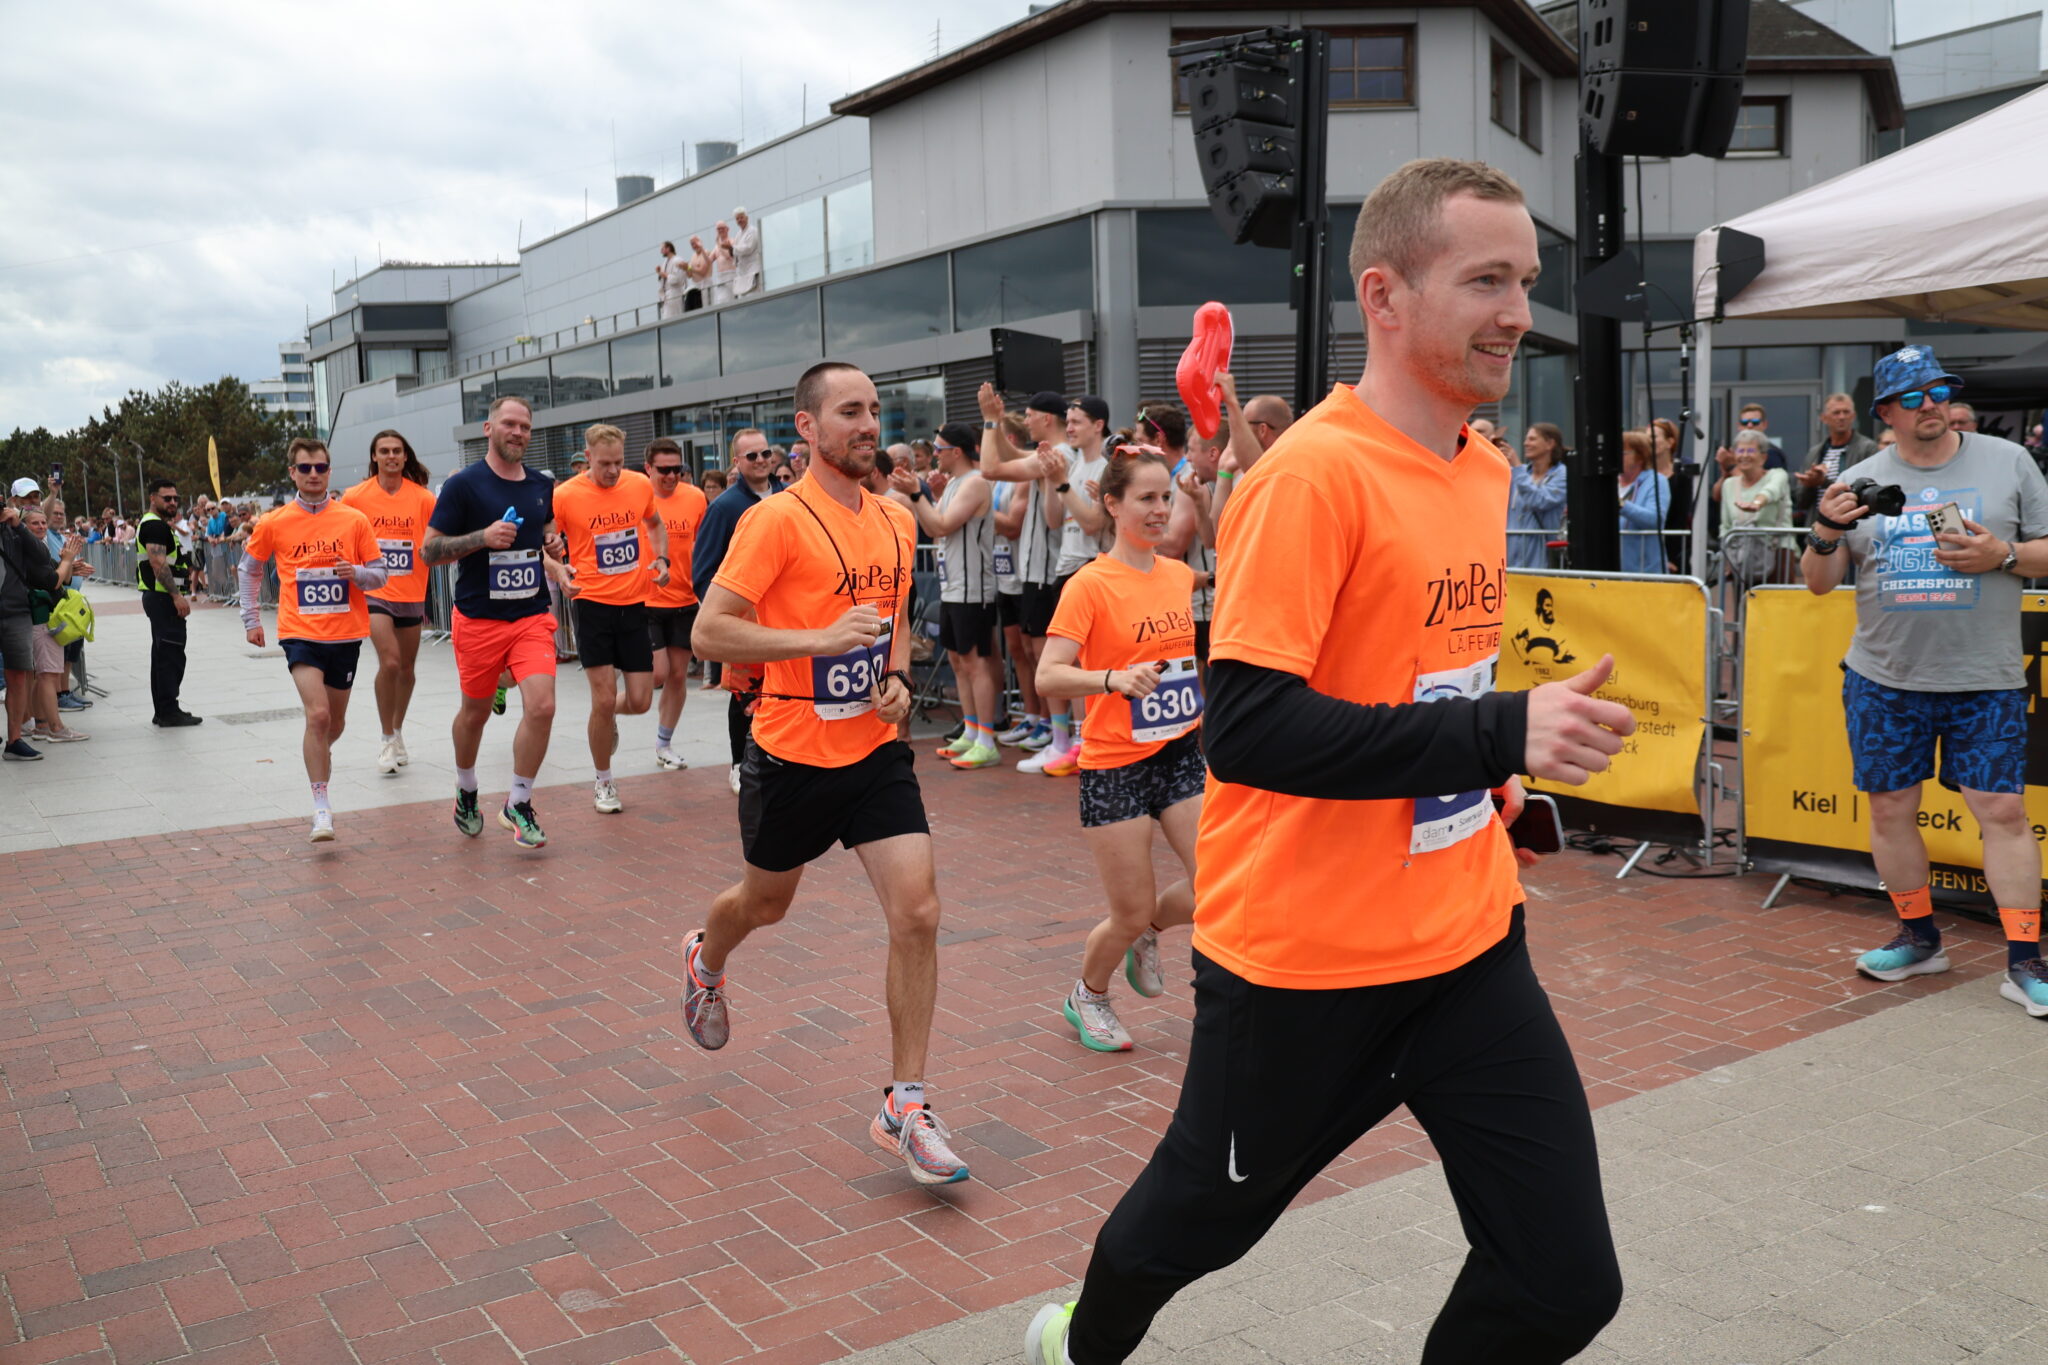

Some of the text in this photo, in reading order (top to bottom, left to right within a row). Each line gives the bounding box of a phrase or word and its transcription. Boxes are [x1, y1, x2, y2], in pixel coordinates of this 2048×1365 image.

[1885, 509, 1974, 538] PASN
[602, 544, 636, 566] 630
[1872, 538, 1952, 575] LIGH
[497, 567, 536, 588] 630
[834, 565, 906, 596] ZipPels
[1882, 579, 1974, 591] CHEERSPORT
[304, 584, 343, 603] 630
[1141, 686, 1197, 722] 630
[1636, 720, 1676, 737] rstedt
[1793, 790, 1963, 832] Kiel eck
